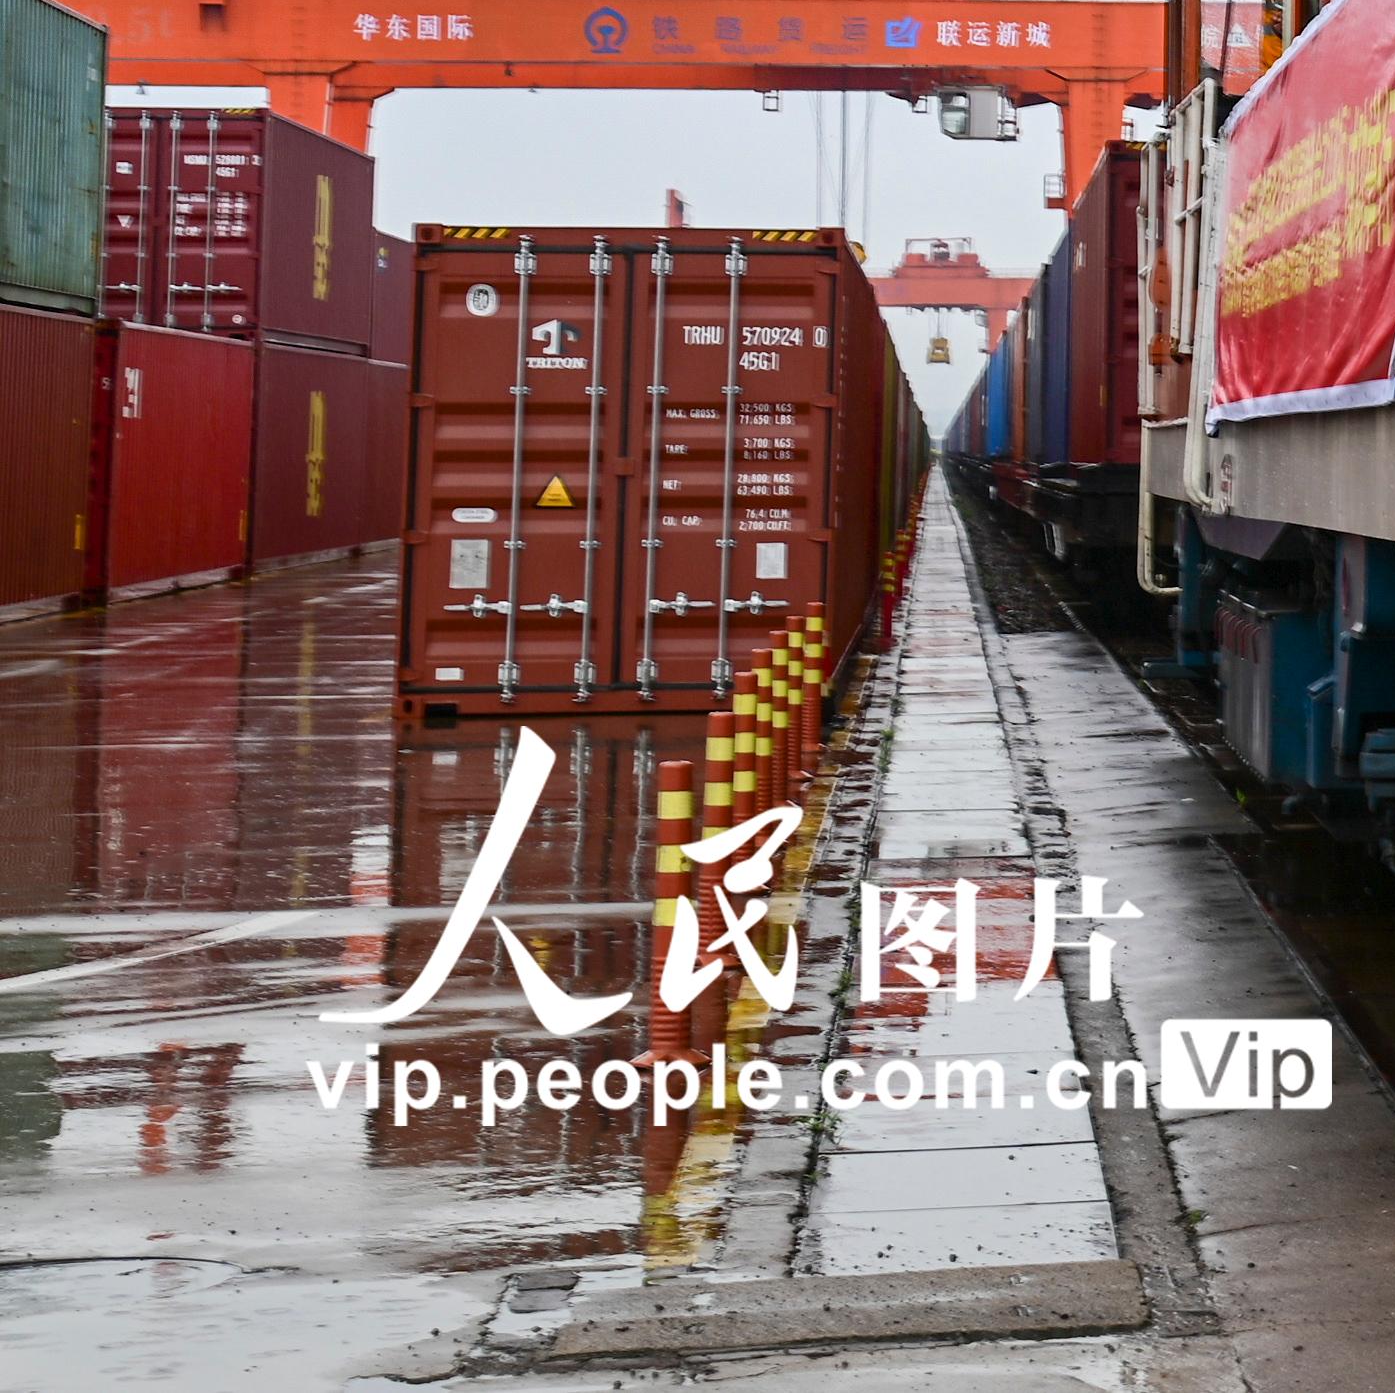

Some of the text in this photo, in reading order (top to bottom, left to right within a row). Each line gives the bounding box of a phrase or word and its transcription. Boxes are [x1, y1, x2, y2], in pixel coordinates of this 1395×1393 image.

[353, 13, 474, 41] 华东国际
[936, 19, 1051, 47] 联运新城
[683, 326, 724, 344] TRHU
[742, 326, 803, 346] 570924
[526, 357, 588, 369] TRITON
[739, 352, 780, 370] 45G1
